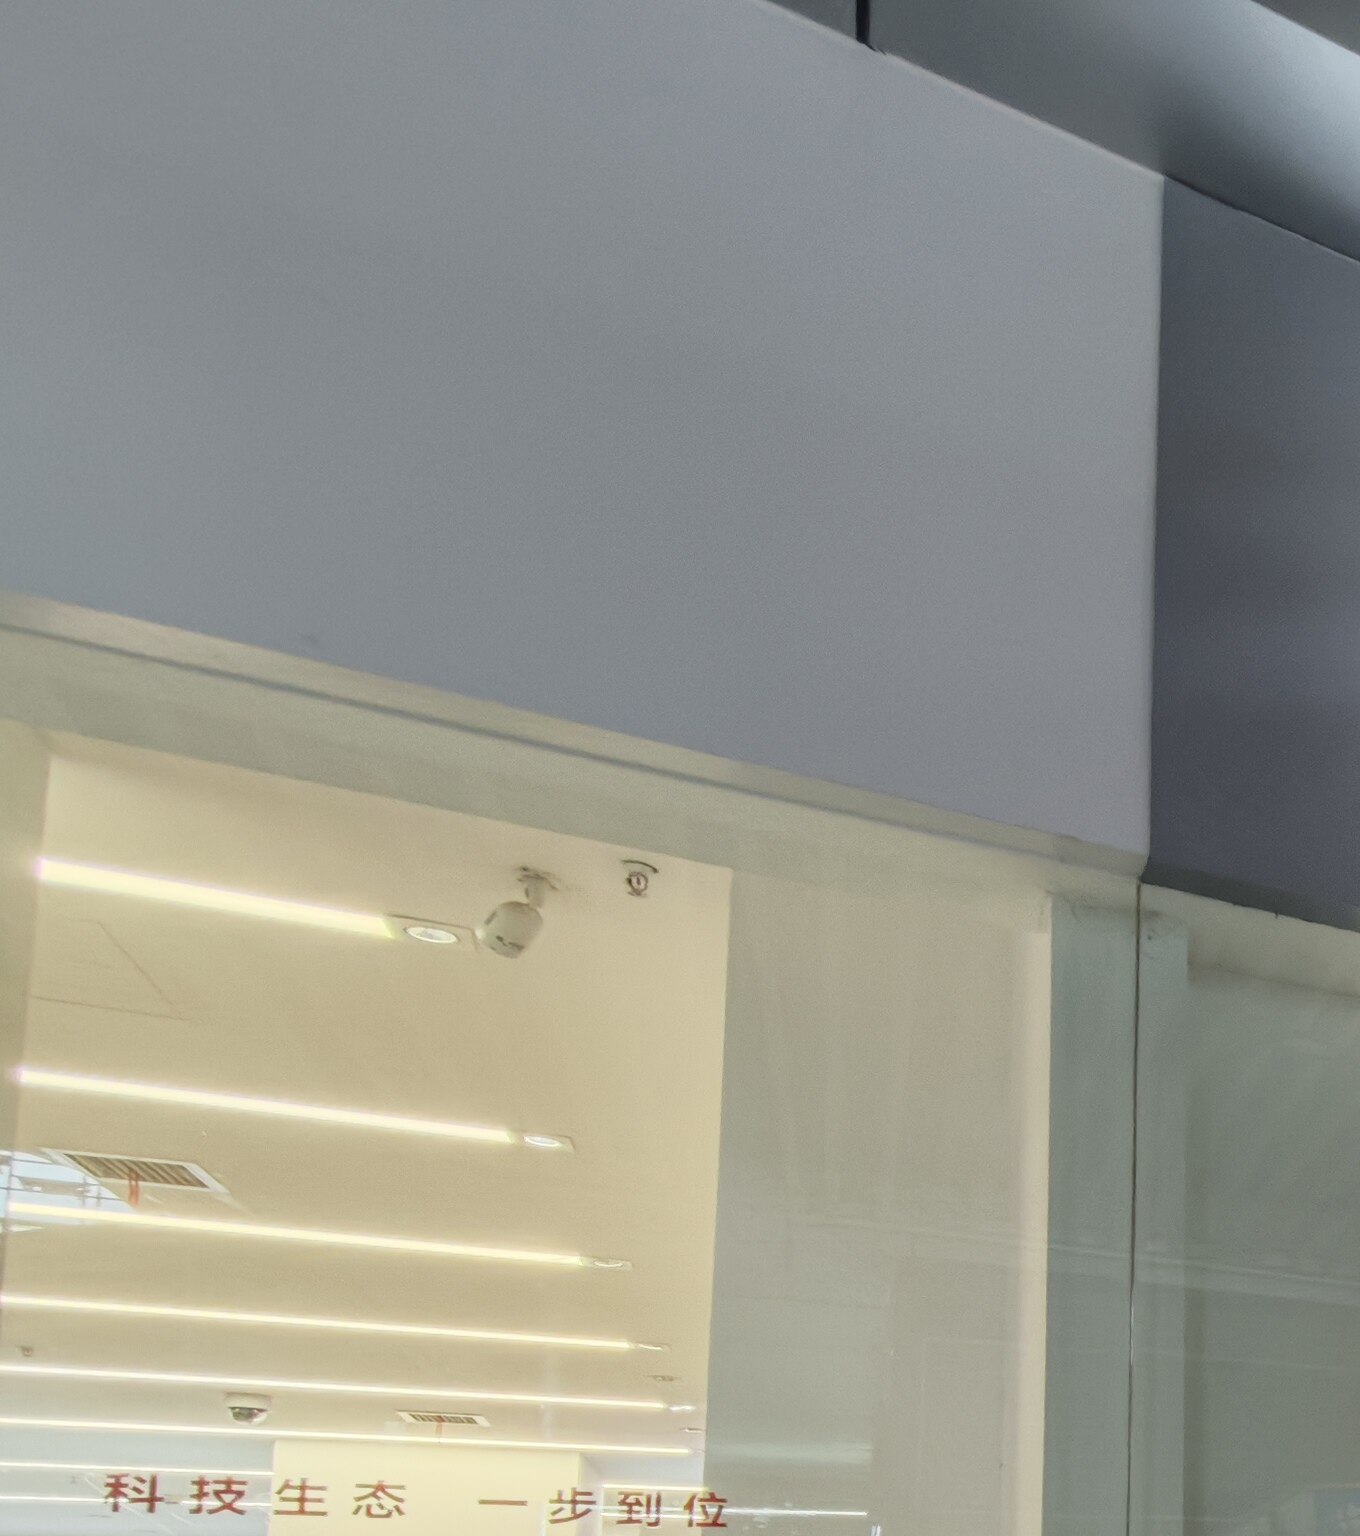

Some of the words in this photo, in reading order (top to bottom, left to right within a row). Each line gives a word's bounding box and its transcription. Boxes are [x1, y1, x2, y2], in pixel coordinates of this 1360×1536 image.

[104, 1472, 408, 1518] 科技生态
[478, 1488, 730, 1529] 一步到位
